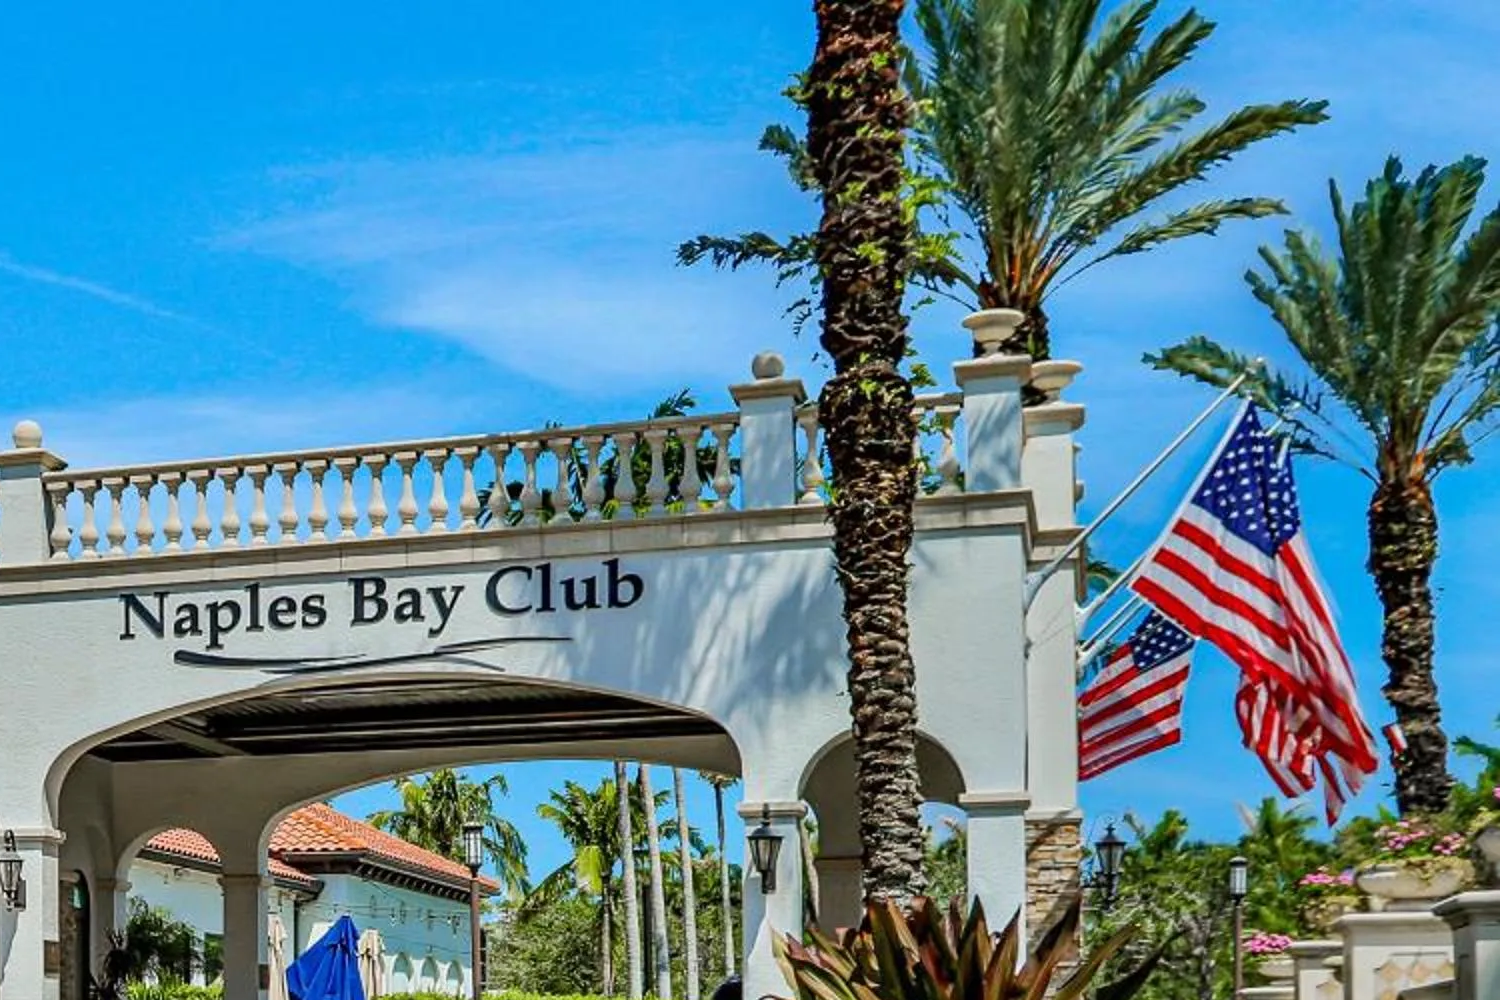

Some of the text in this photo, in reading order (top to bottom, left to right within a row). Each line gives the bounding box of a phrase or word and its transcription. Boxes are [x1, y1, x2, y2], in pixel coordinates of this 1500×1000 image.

[119, 558, 644, 650] Naples Bay Club
